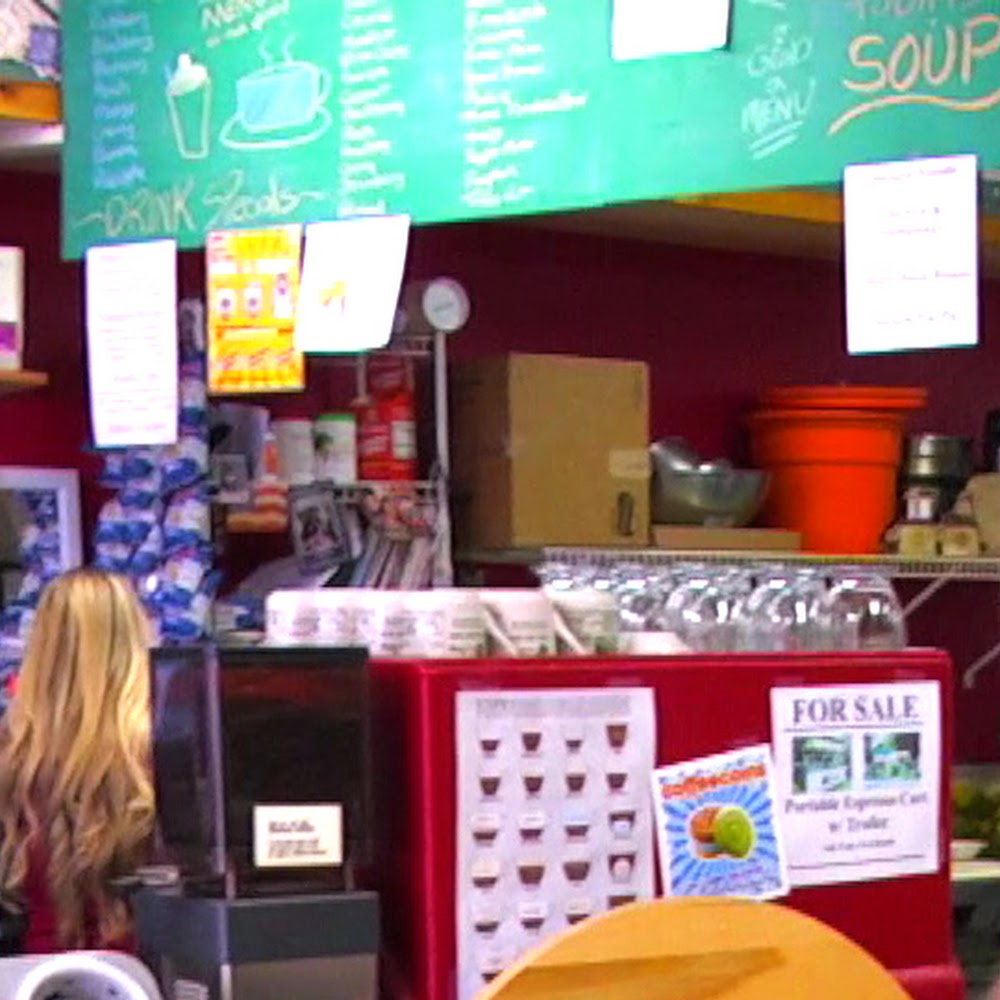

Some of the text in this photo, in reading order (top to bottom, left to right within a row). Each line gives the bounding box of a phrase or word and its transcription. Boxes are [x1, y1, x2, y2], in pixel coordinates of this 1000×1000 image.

[740, 78, 817, 133] MENU
[792, 695, 920, 724] FOR SALE
